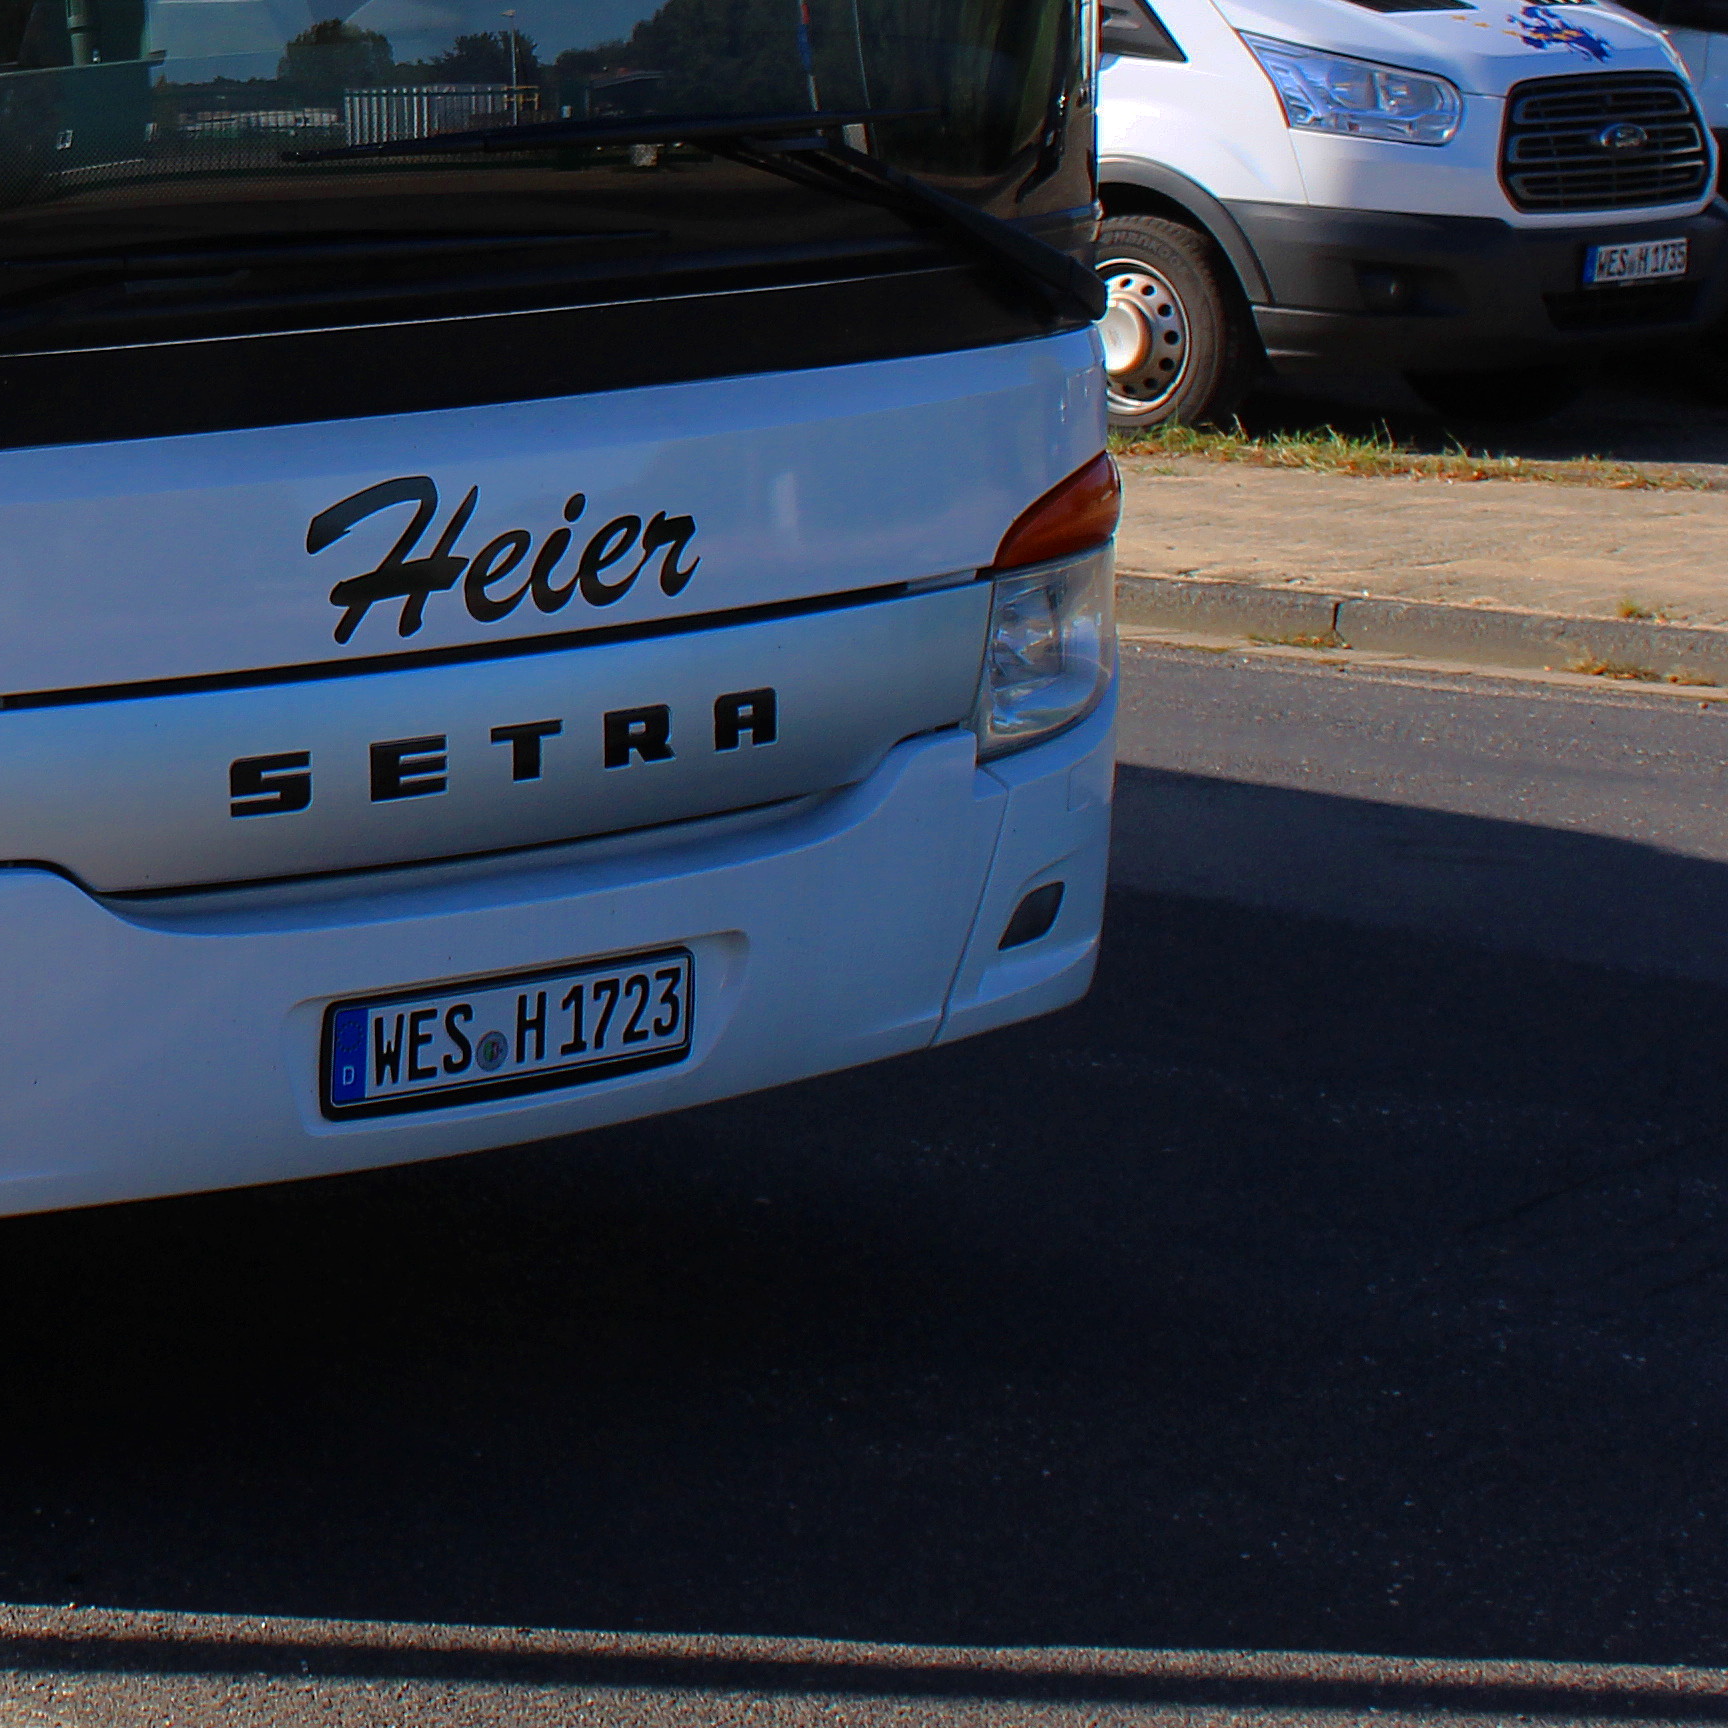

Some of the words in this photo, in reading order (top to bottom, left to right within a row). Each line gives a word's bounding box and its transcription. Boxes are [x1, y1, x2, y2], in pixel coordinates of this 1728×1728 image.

[306, 475, 701, 646] Heier
[229, 687, 780, 819] SETRA
[342, 1065, 356, 1086] D
[374, 1003, 474, 1087] WES
[516, 991, 548, 1064] H
[560, 966, 682, 1056] 1723
